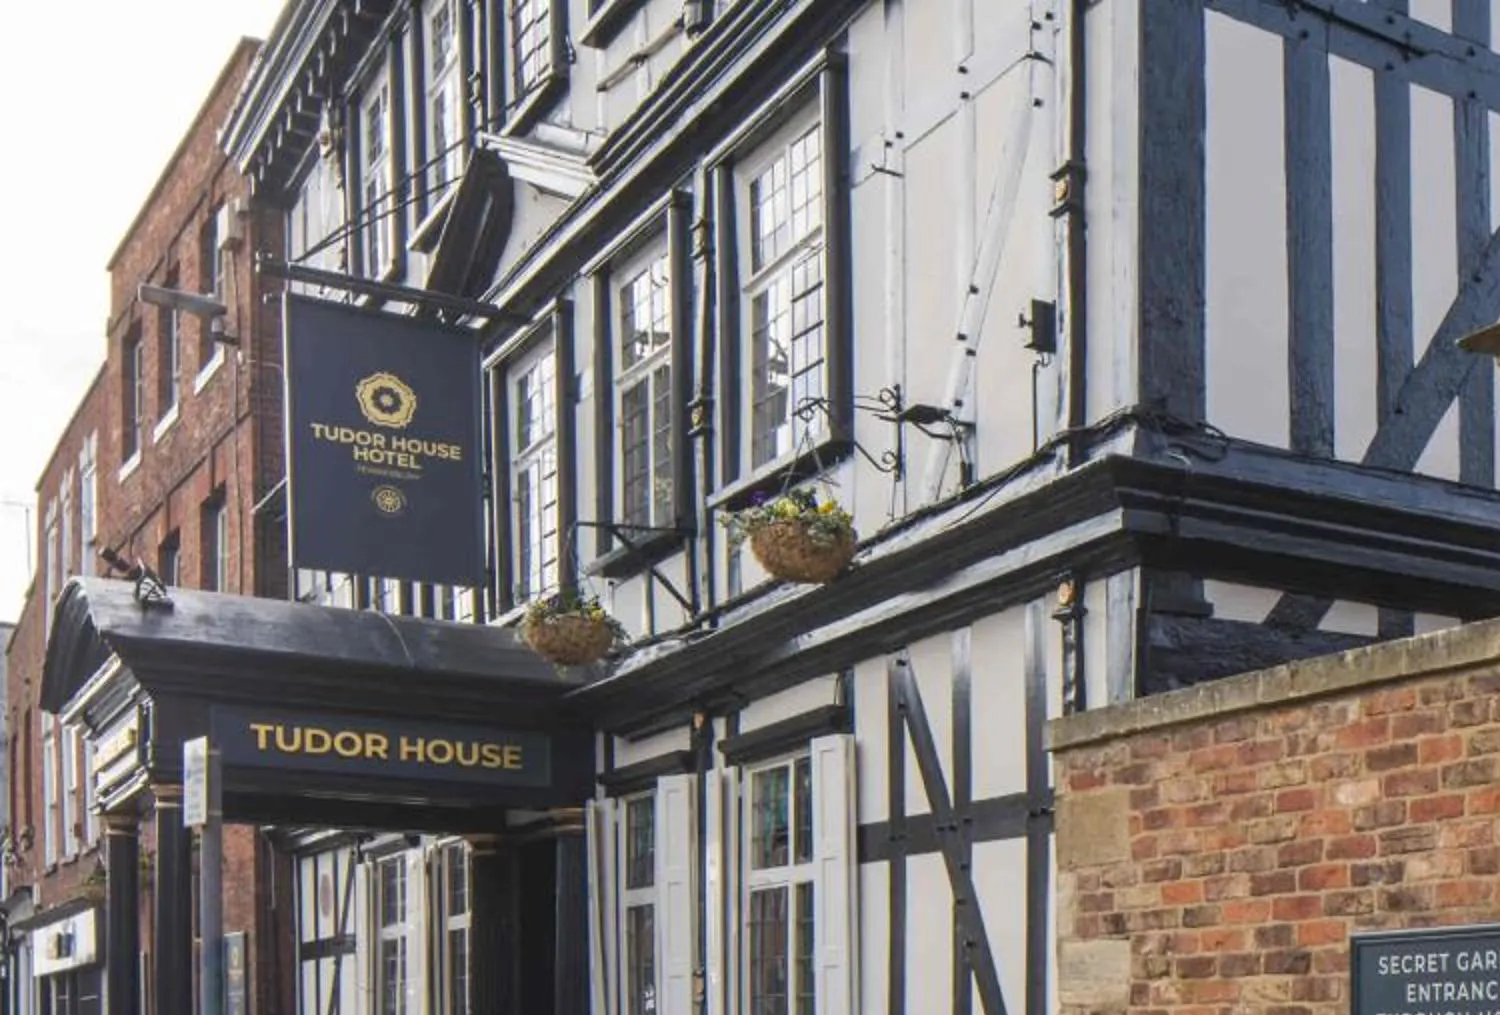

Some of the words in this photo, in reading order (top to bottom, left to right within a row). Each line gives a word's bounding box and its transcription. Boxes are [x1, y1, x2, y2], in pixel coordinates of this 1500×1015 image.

[310, 422, 386, 449] TUDOR
[391, 435, 462, 461] HOUSE
[353, 445, 423, 470] HOTEL
[250, 723, 389, 760] TUDOR
[400, 736, 522, 769] HOUSE
[1378, 953, 1449, 975] SECRET
